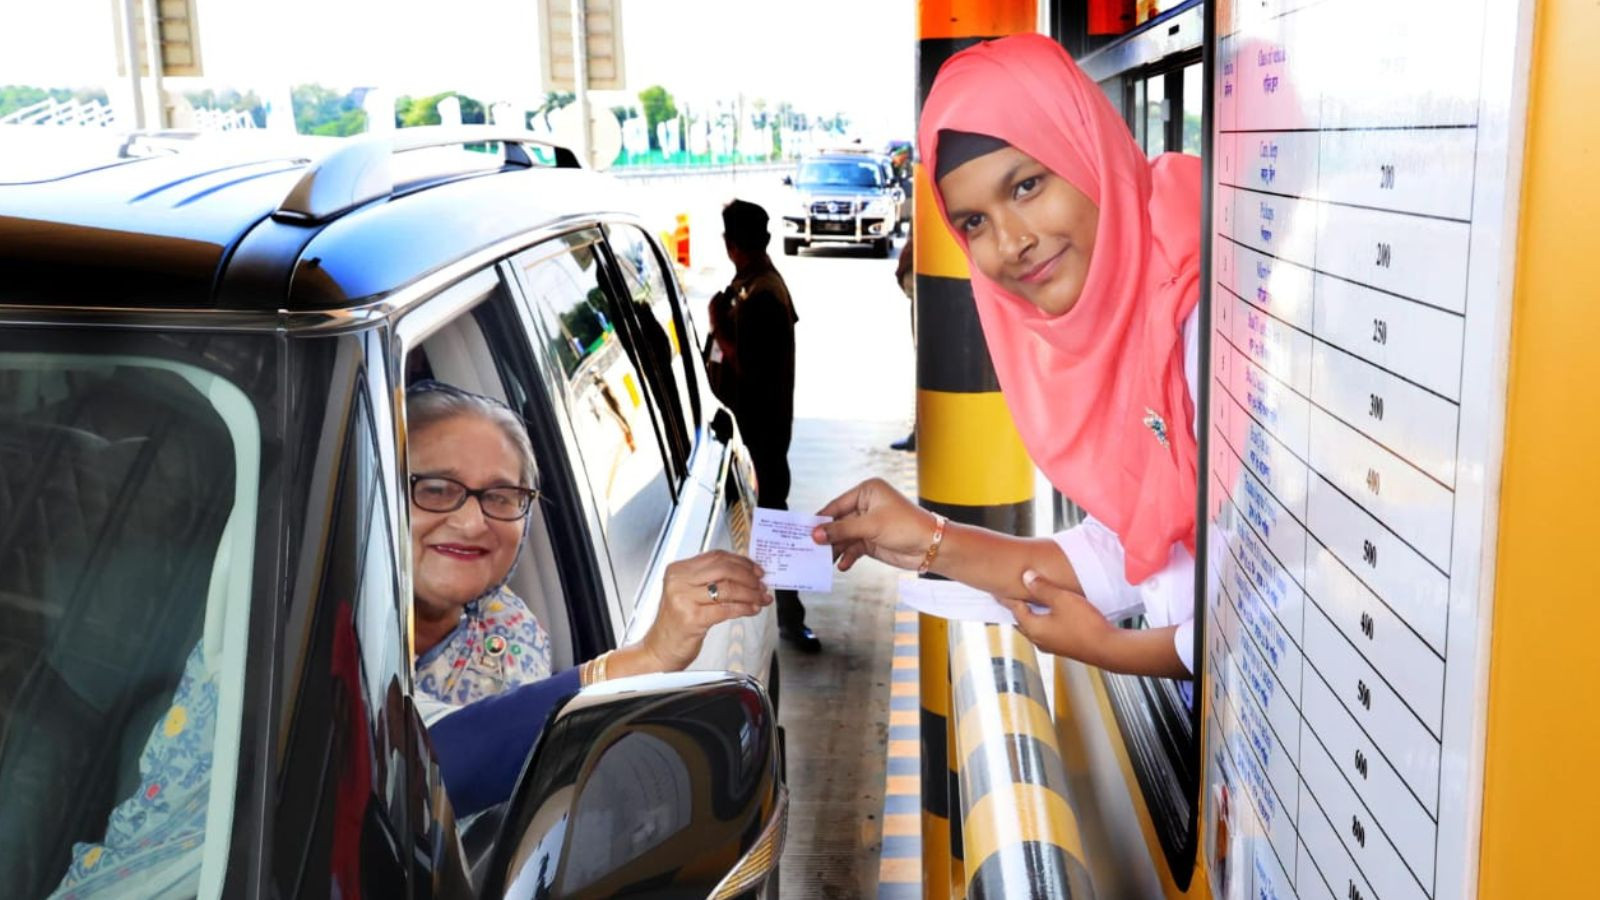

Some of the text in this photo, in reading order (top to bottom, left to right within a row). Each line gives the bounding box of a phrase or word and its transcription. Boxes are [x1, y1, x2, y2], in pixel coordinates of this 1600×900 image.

[1380, 164, 1395, 190] 200
[1375, 243, 1391, 269] 200
[1372, 319, 1387, 346] 250
[1368, 394, 1384, 421] 300
[1366, 468, 1380, 496] 400
[1362, 539, 1377, 568] 500
[1360, 611, 1374, 641] 400
[1357, 679, 1371, 711] 500
[1354, 749, 1368, 781] 600
[1352, 814, 1365, 848] 800
[1348, 878, 1364, 900] 100
